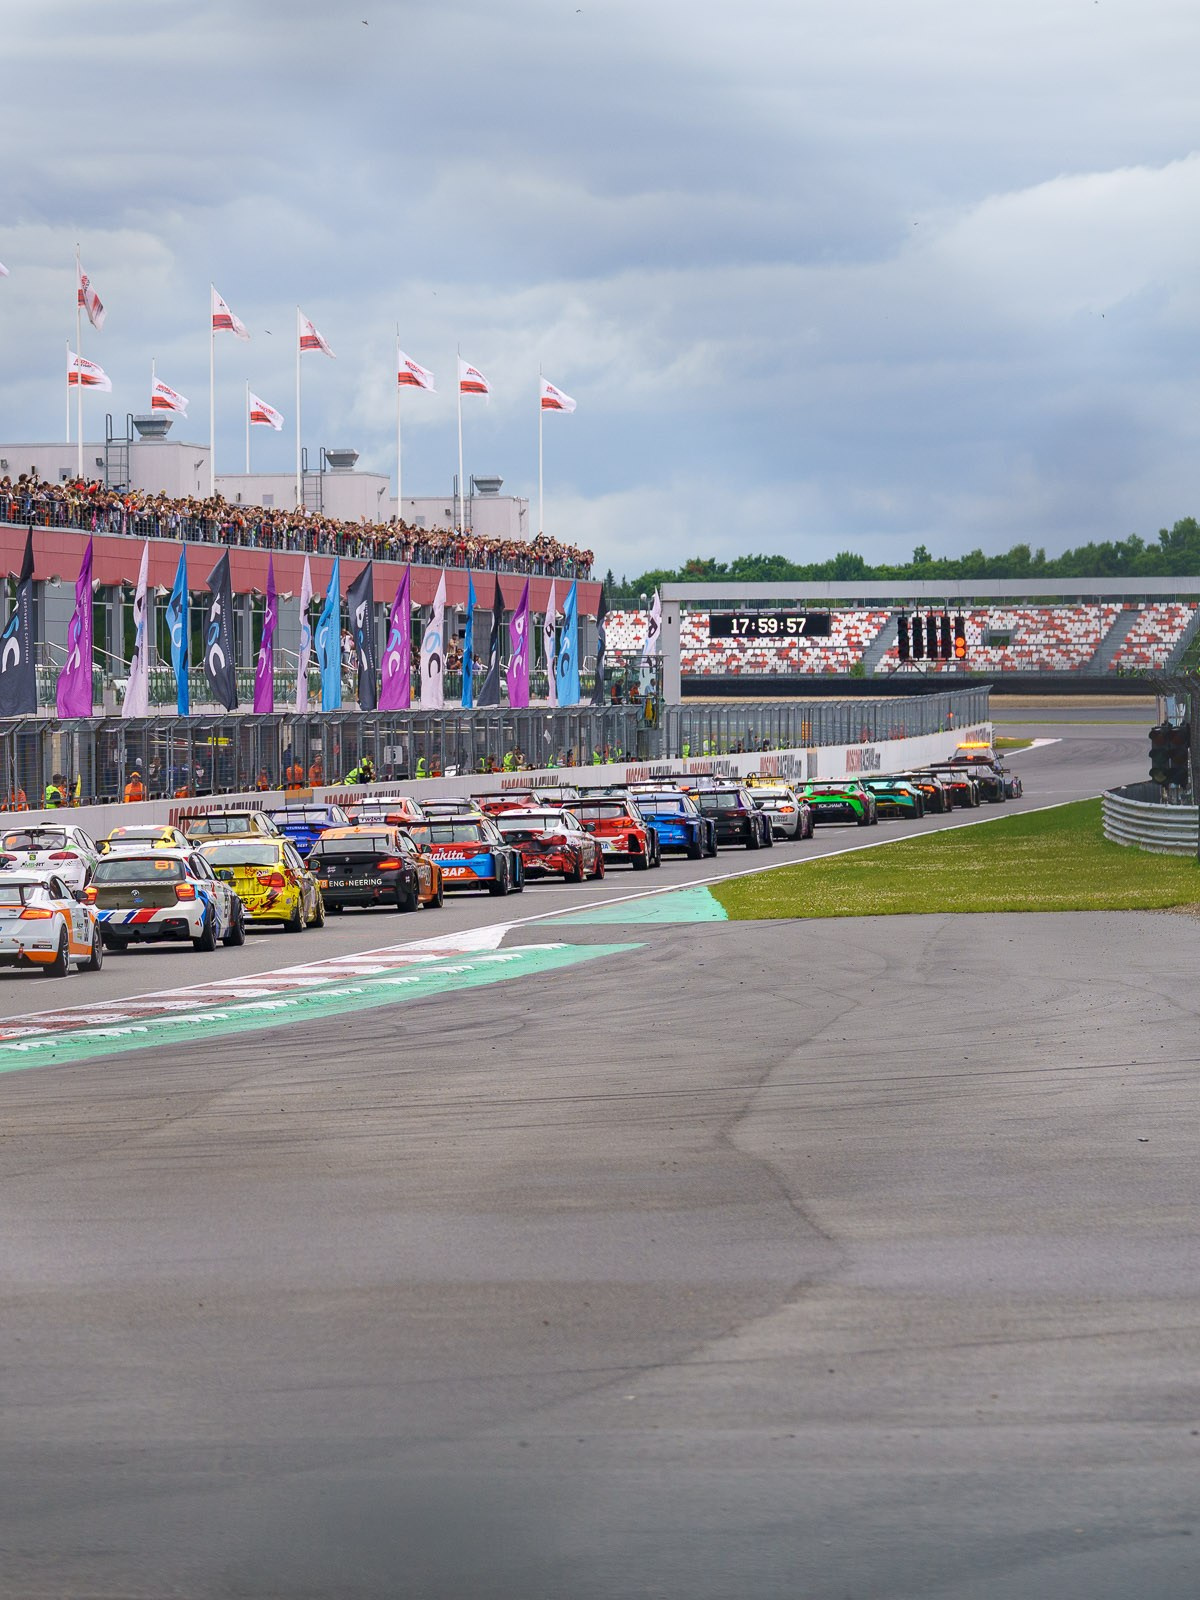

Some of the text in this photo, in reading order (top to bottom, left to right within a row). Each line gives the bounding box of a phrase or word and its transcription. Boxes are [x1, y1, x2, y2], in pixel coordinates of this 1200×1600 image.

[730, 617, 807, 634] 17:59:57
[428, 849, 466, 861] akita
[154, 860, 175, 870] 81
